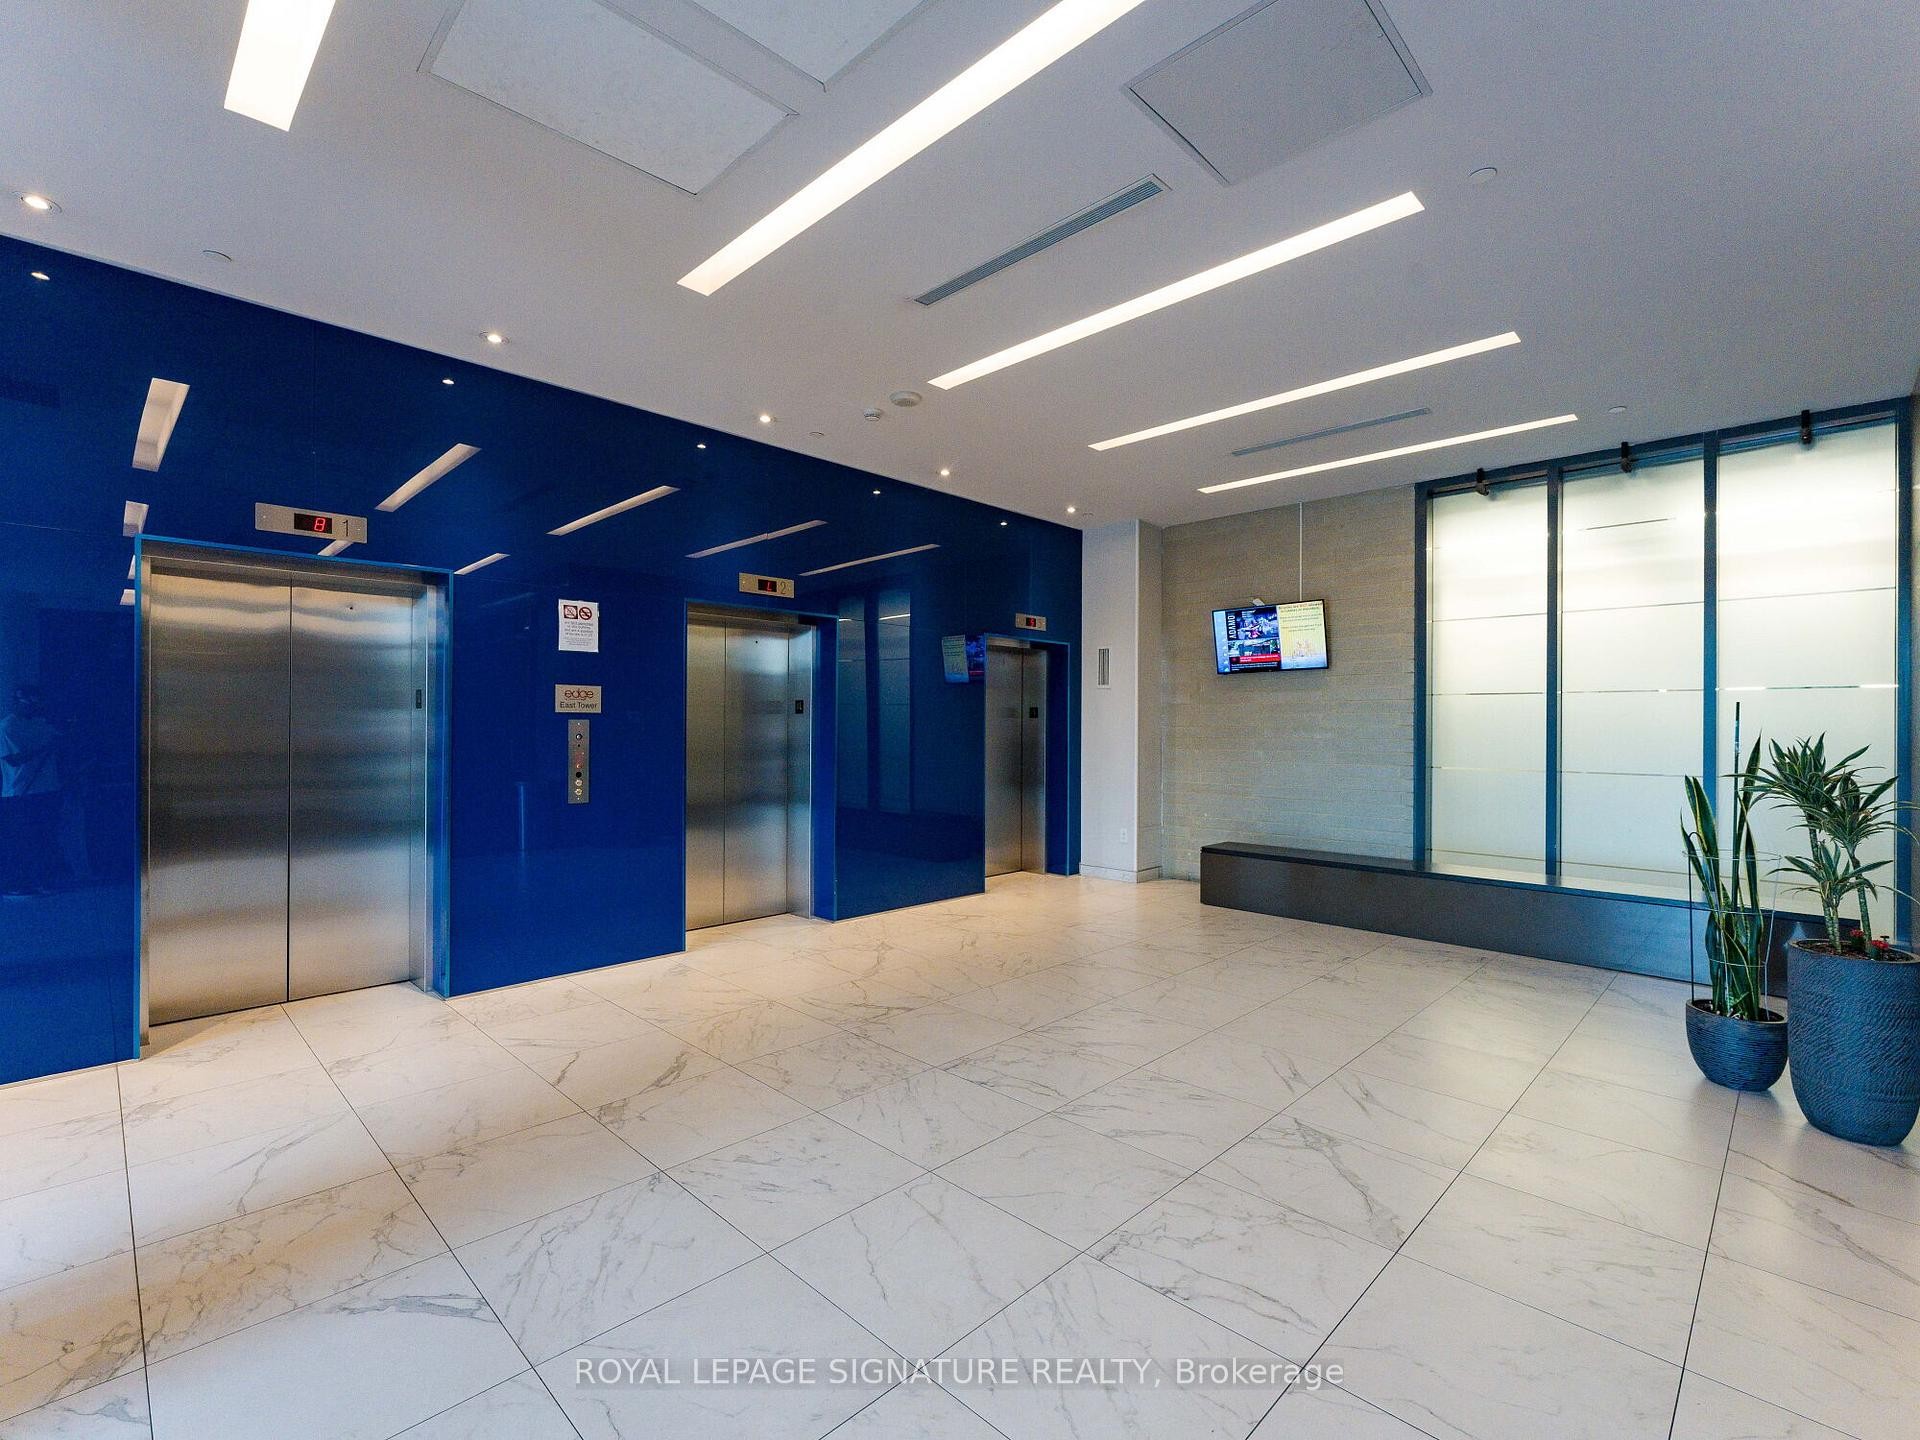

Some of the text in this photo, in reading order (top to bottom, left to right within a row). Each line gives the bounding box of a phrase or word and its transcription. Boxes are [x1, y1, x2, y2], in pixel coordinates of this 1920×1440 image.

[314, 517, 326, 532] 8
[341, 519, 349, 537] 1
[564, 689, 594, 701] edge
[560, 701, 598, 710] East Tower
